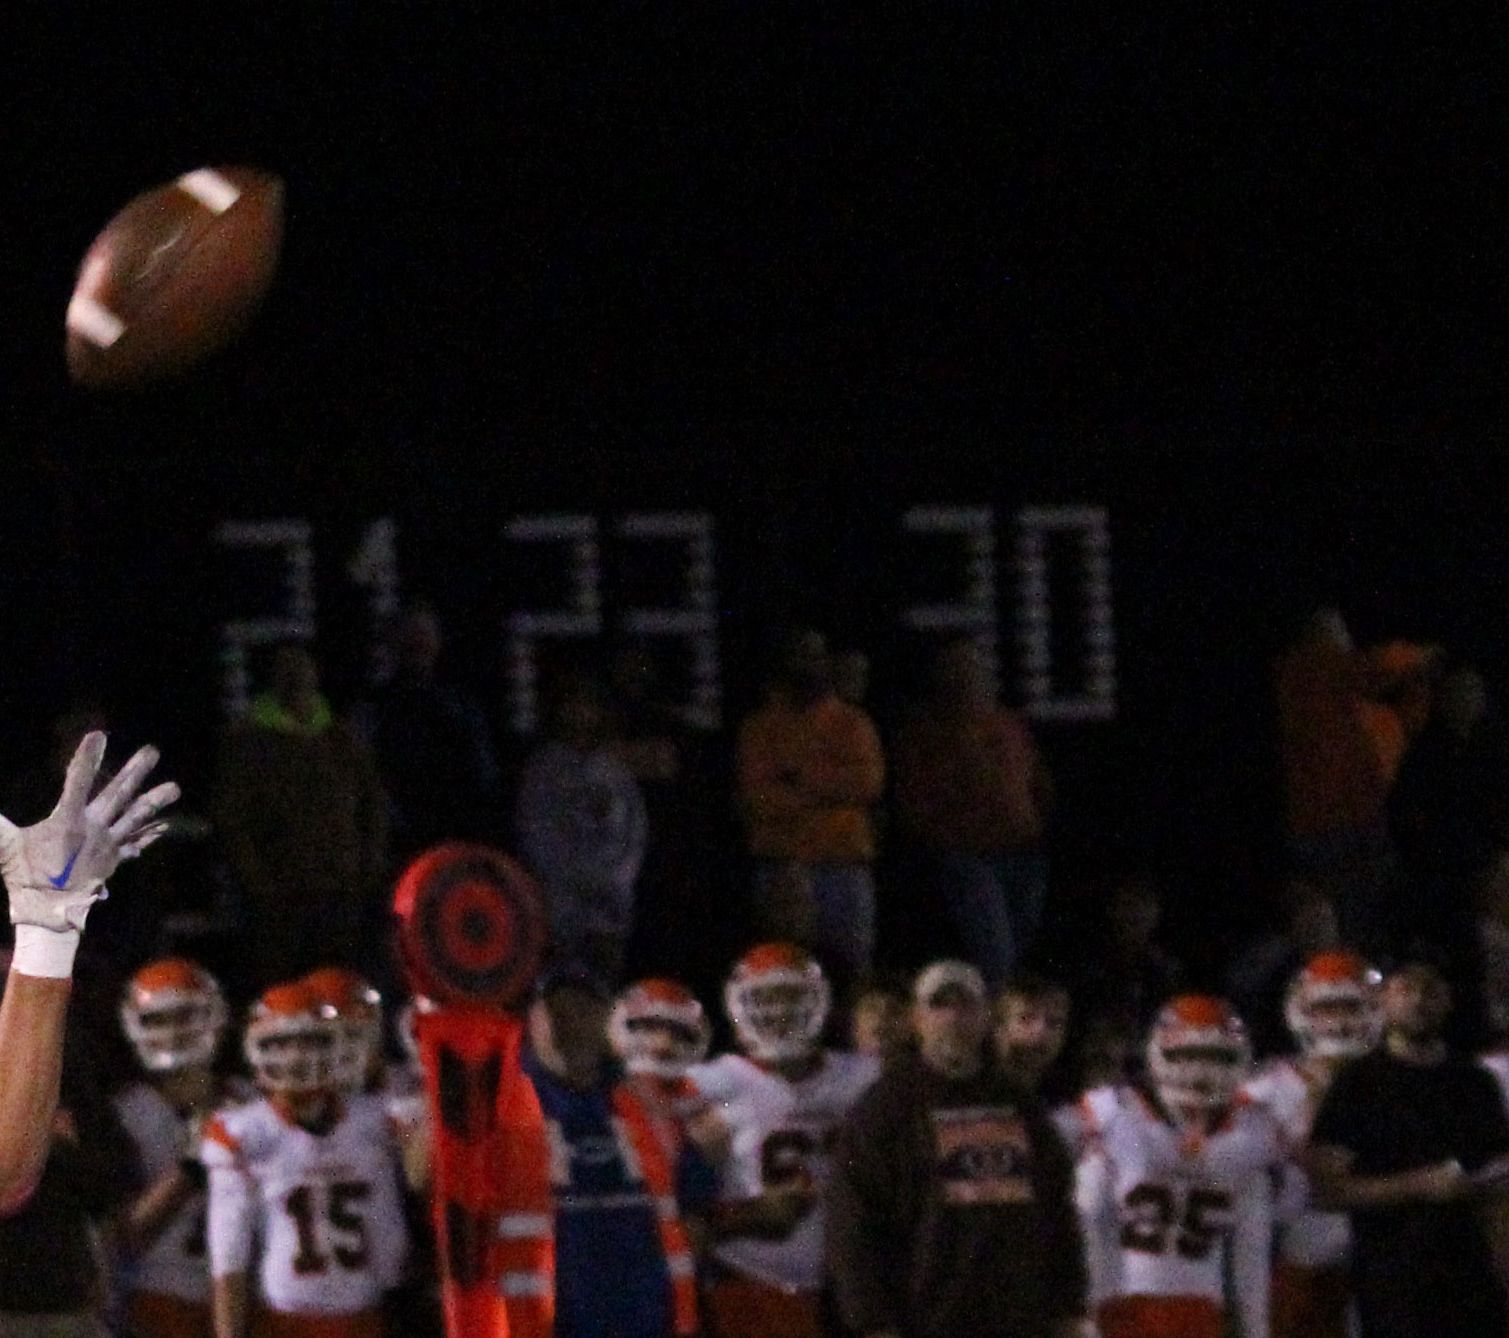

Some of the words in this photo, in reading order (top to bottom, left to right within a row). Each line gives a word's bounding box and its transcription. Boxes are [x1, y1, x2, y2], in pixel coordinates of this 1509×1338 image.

[210, 514, 401, 716] 21
[502, 507, 721, 734] 23
[900, 502, 1119, 721] 30
[286, 1182, 372, 1276] 15
